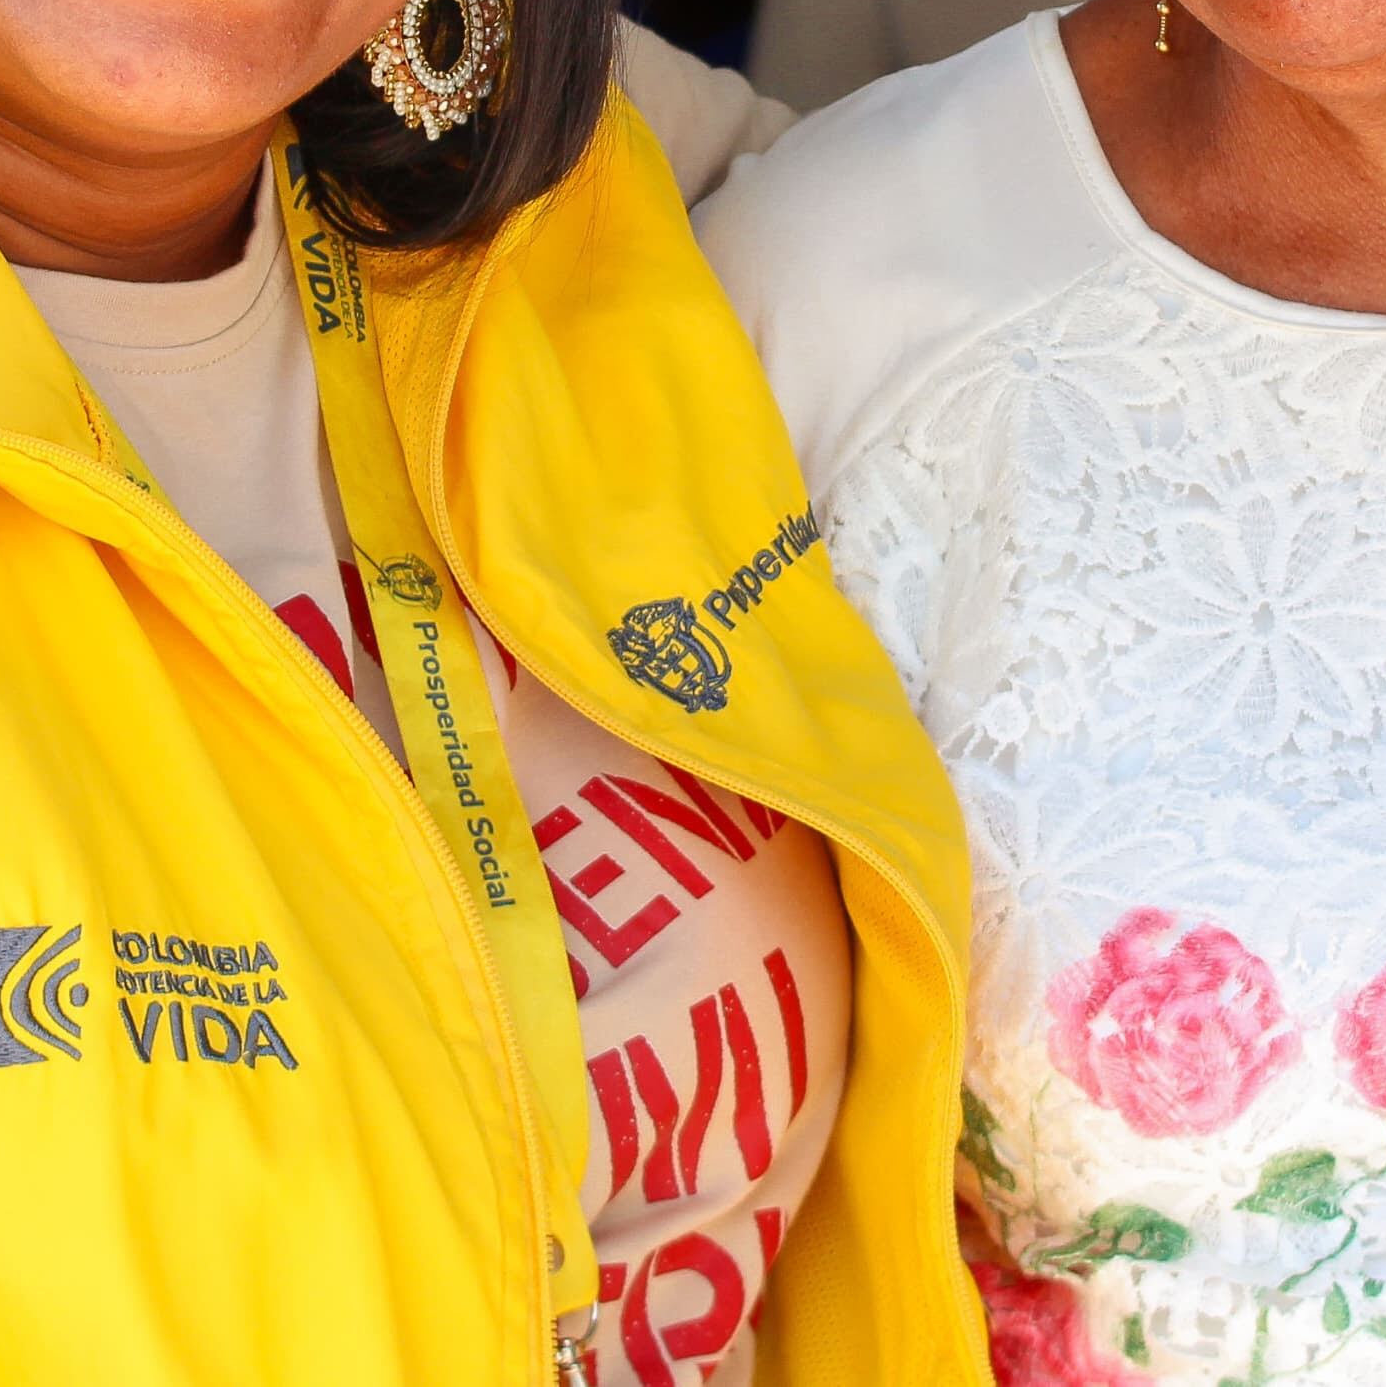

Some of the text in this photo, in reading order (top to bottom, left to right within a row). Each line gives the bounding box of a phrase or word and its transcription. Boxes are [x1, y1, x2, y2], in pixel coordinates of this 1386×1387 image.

[301, 231, 341, 334] VIDA
[341, 301, 352, 319] DE
[344, 240, 366, 342] COLOMBIA
[344, 322, 353, 339] LA
[414, 621, 516, 908] Prosperidad Social
[112, 929, 279, 975] COLOMBIA
[217, 982, 250, 1006] DE
[254, 978, 288, 1004] LA
[118, 998, 299, 1070] VIDA
